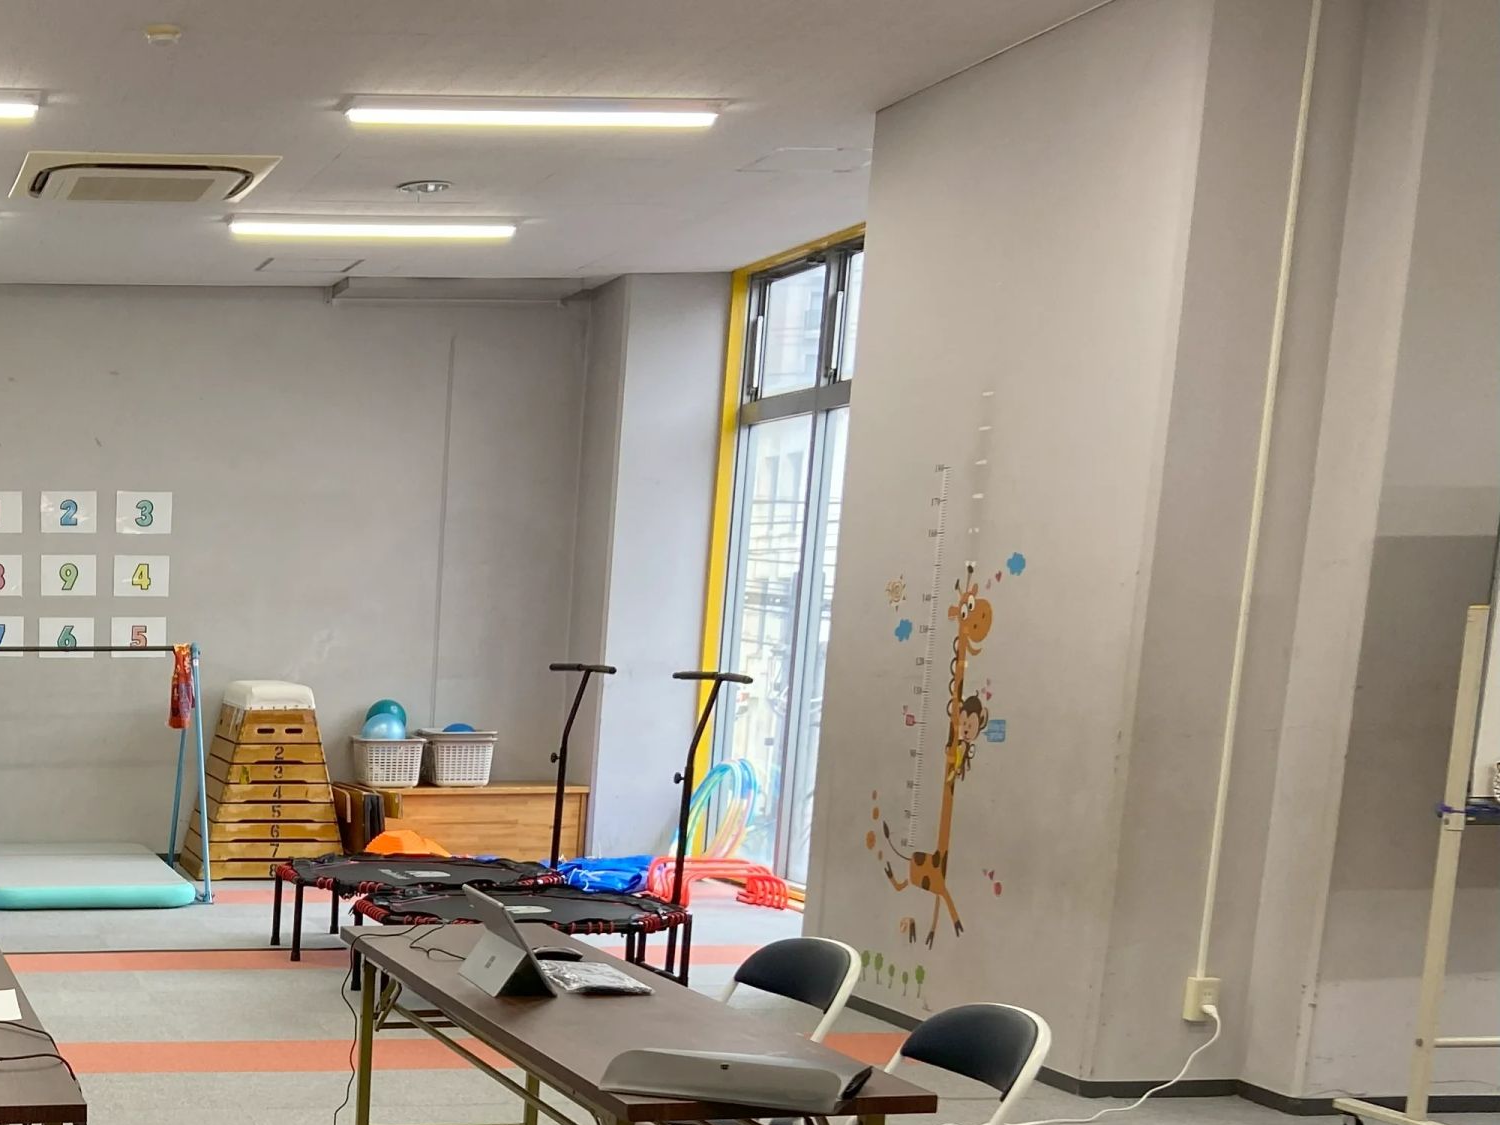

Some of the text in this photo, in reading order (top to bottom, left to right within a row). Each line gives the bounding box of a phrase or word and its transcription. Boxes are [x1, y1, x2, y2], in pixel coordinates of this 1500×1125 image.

[59, 499, 78, 526] 2
[134, 499, 154, 527] 3
[59, 563, 79, 590] 9
[131, 563, 151, 590] 4
[57, 625, 77, 652] 6
[129, 625, 148, 648] 5
[274, 746, 285, 760] 2
[273, 765, 283, 779] 3
[272, 785, 282, 799] 4
[271, 804, 281, 818] 5
[270, 824, 280, 838] 6
[269, 843, 280, 857] 7
